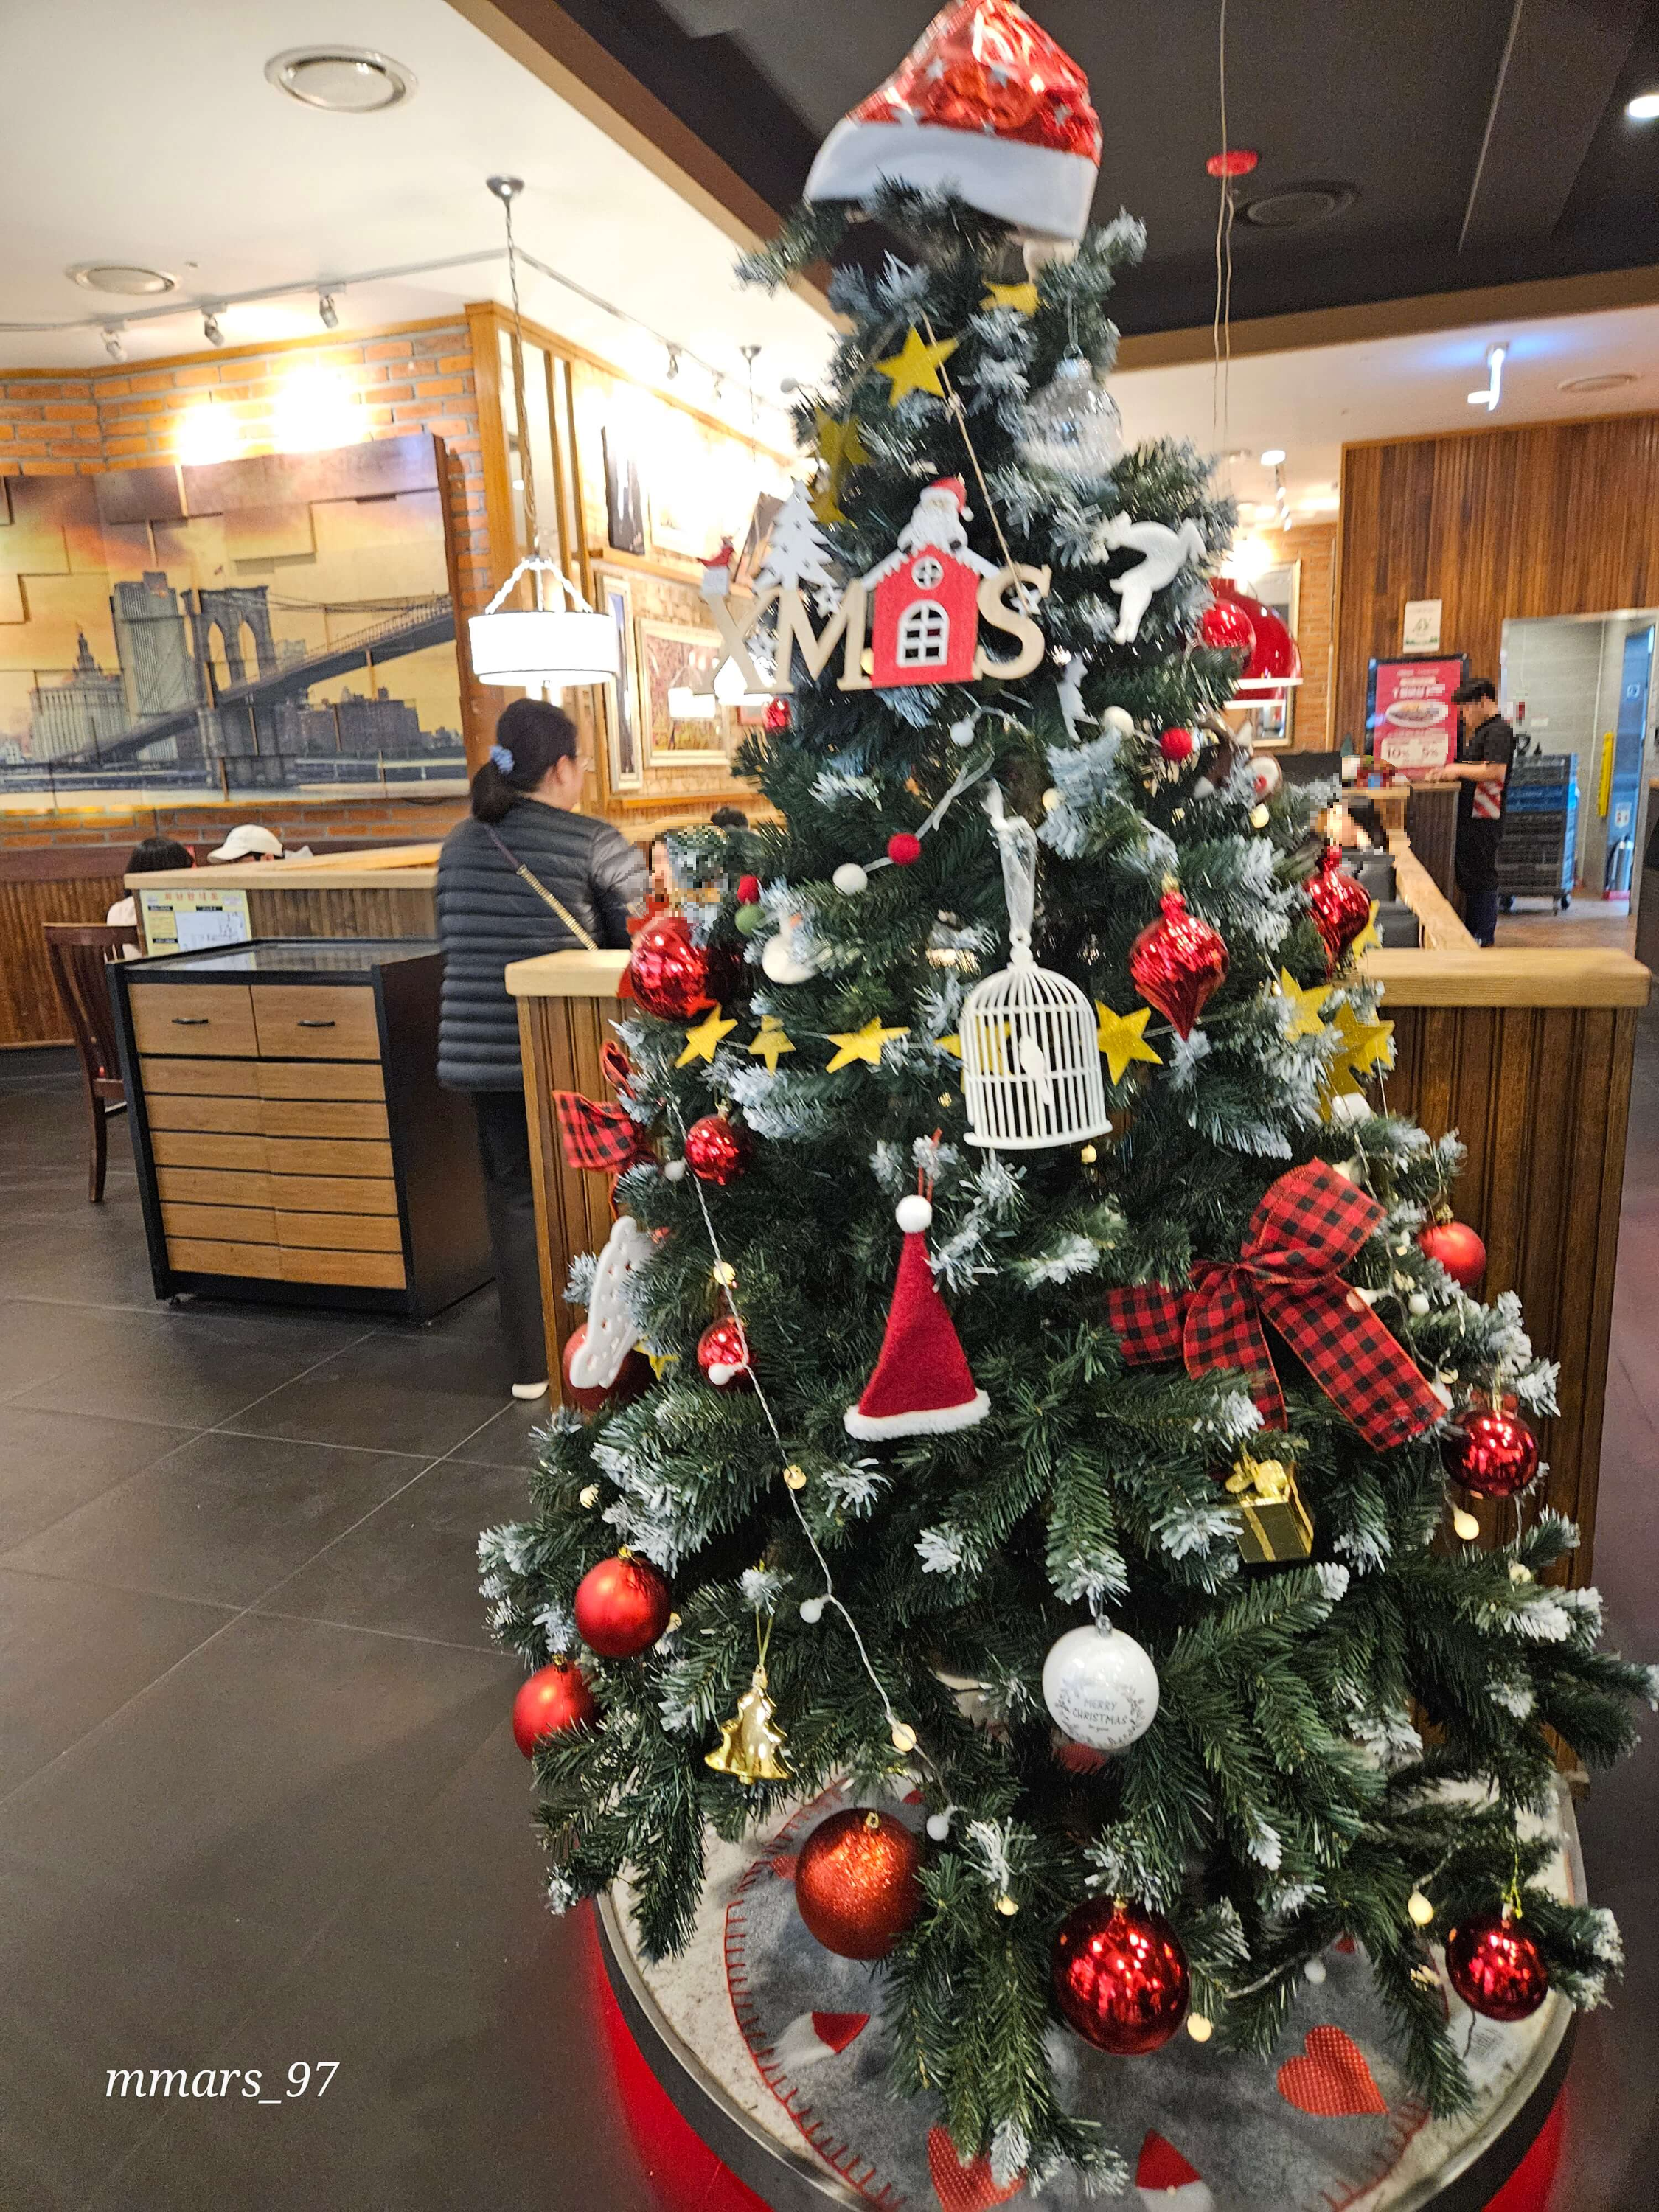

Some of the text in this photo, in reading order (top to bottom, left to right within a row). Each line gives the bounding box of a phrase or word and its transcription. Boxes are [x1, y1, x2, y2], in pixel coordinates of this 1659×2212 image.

[692, 562, 1052, 695] XMS
[1084, 1698, 1117, 1711] MERRY
[1073, 1708, 1128, 1725] CHRISTMAS
